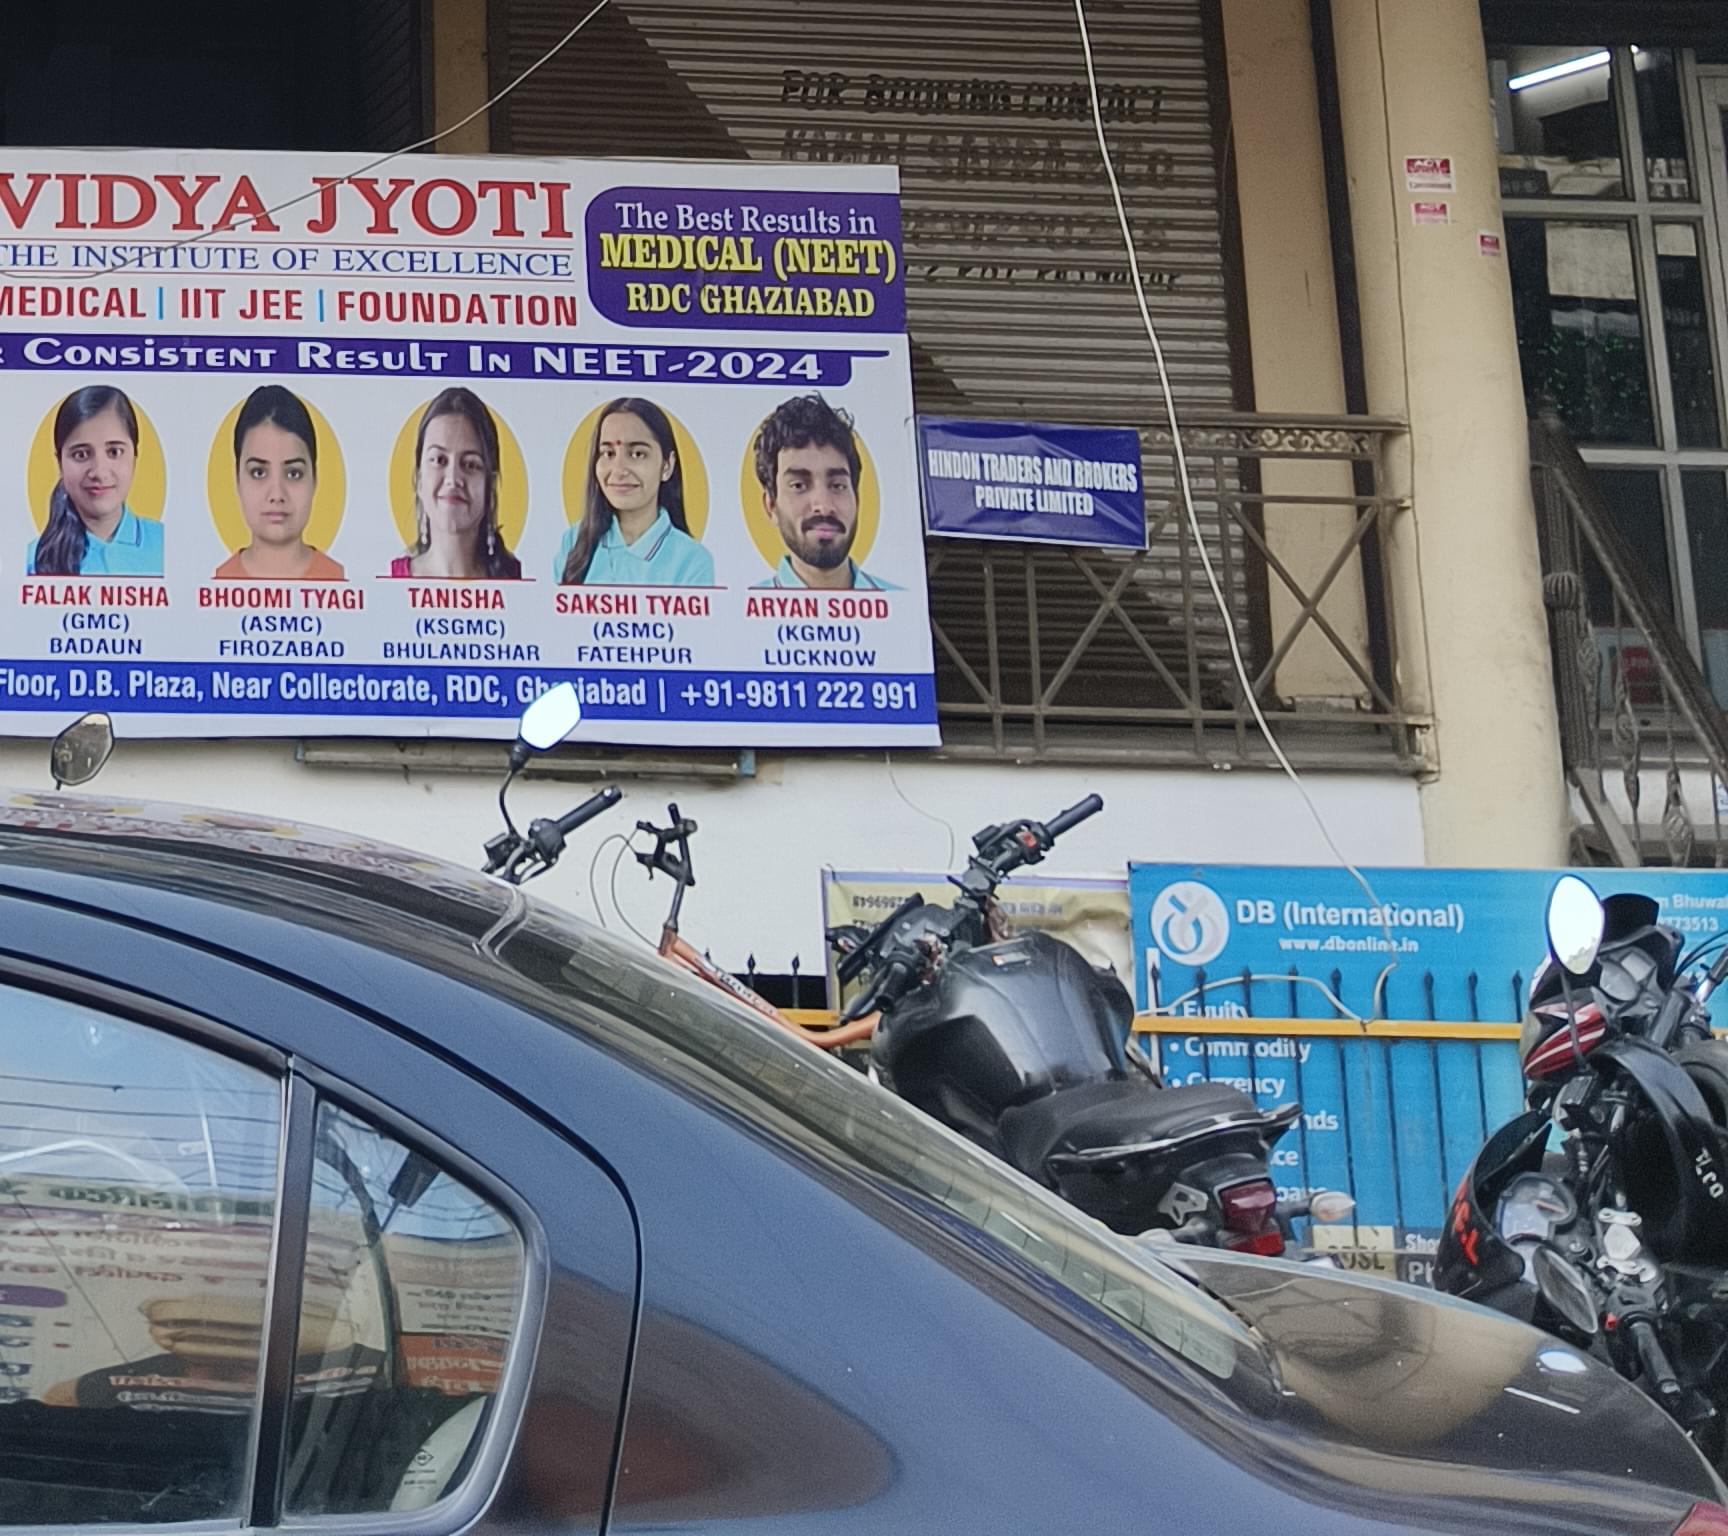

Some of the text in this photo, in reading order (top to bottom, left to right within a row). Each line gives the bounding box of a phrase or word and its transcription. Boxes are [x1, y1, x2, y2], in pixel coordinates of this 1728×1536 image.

[307, 177, 573, 239] JYOTI
[615, 202, 669, 229] The
[676, 204, 733, 232] Best
[741, 205, 841, 235] Results
[847, 208, 877, 235] in
[72, 245, 259, 270] INSTITUTE
[272, 248, 317, 270] OF
[334, 249, 573, 276] EXCELLENCE
[600, 232, 762, 273] MEDICAL
[774, 237, 897, 284] (NEET)
[181, 288, 225, 319] IIT
[240, 288, 303, 321] JEE
[338, 291, 578, 326] FOUNDATION
[626, 283, 875, 317] RDC GHAZIABAD
[534, 346, 822, 380] NEET-2024
[928, 448, 1138, 493] HINDON TRADERS AND BROKERS
[975, 485, 1094, 516] PRIVATE LIMITED
[21, 585, 169, 607] FALAK NISHA
[198, 588, 364, 611] BHOOMI TYAGI
[408, 588, 505, 611] TANISHA
[556, 593, 710, 618] SAKSHI TYAGI
[746, 597, 890, 620] ARYAN SOOD
[61, 611, 130, 633] (GMC)
[241, 614, 322, 636] (ASMC)
[415, 616, 505, 639] (KSGMC)
[593, 620, 675, 642] (ASMC)
[777, 623, 862, 645] (KGMU)
[50, 638, 142, 656] BADAUN
[219, 639, 345, 658] FIROZABAD
[383, 641, 540, 661] BHULANDSHAR
[577, 645, 693, 665] FATEHPUR
[763, 648, 877, 667] LUCKNOW
[69, 670, 120, 698] D.B.
[128, 671, 203, 703] Plaza,
[211, 672, 273, 701] Near
[279, 674, 438, 706] Collectorate,
[445, 676, 509, 708] RDC,
[680, 682, 806, 709] +91-9811
[816, 682, 864, 709] 222
[873, 682, 918, 710] 991
[1235, 899, 1465, 933] DB (International)
